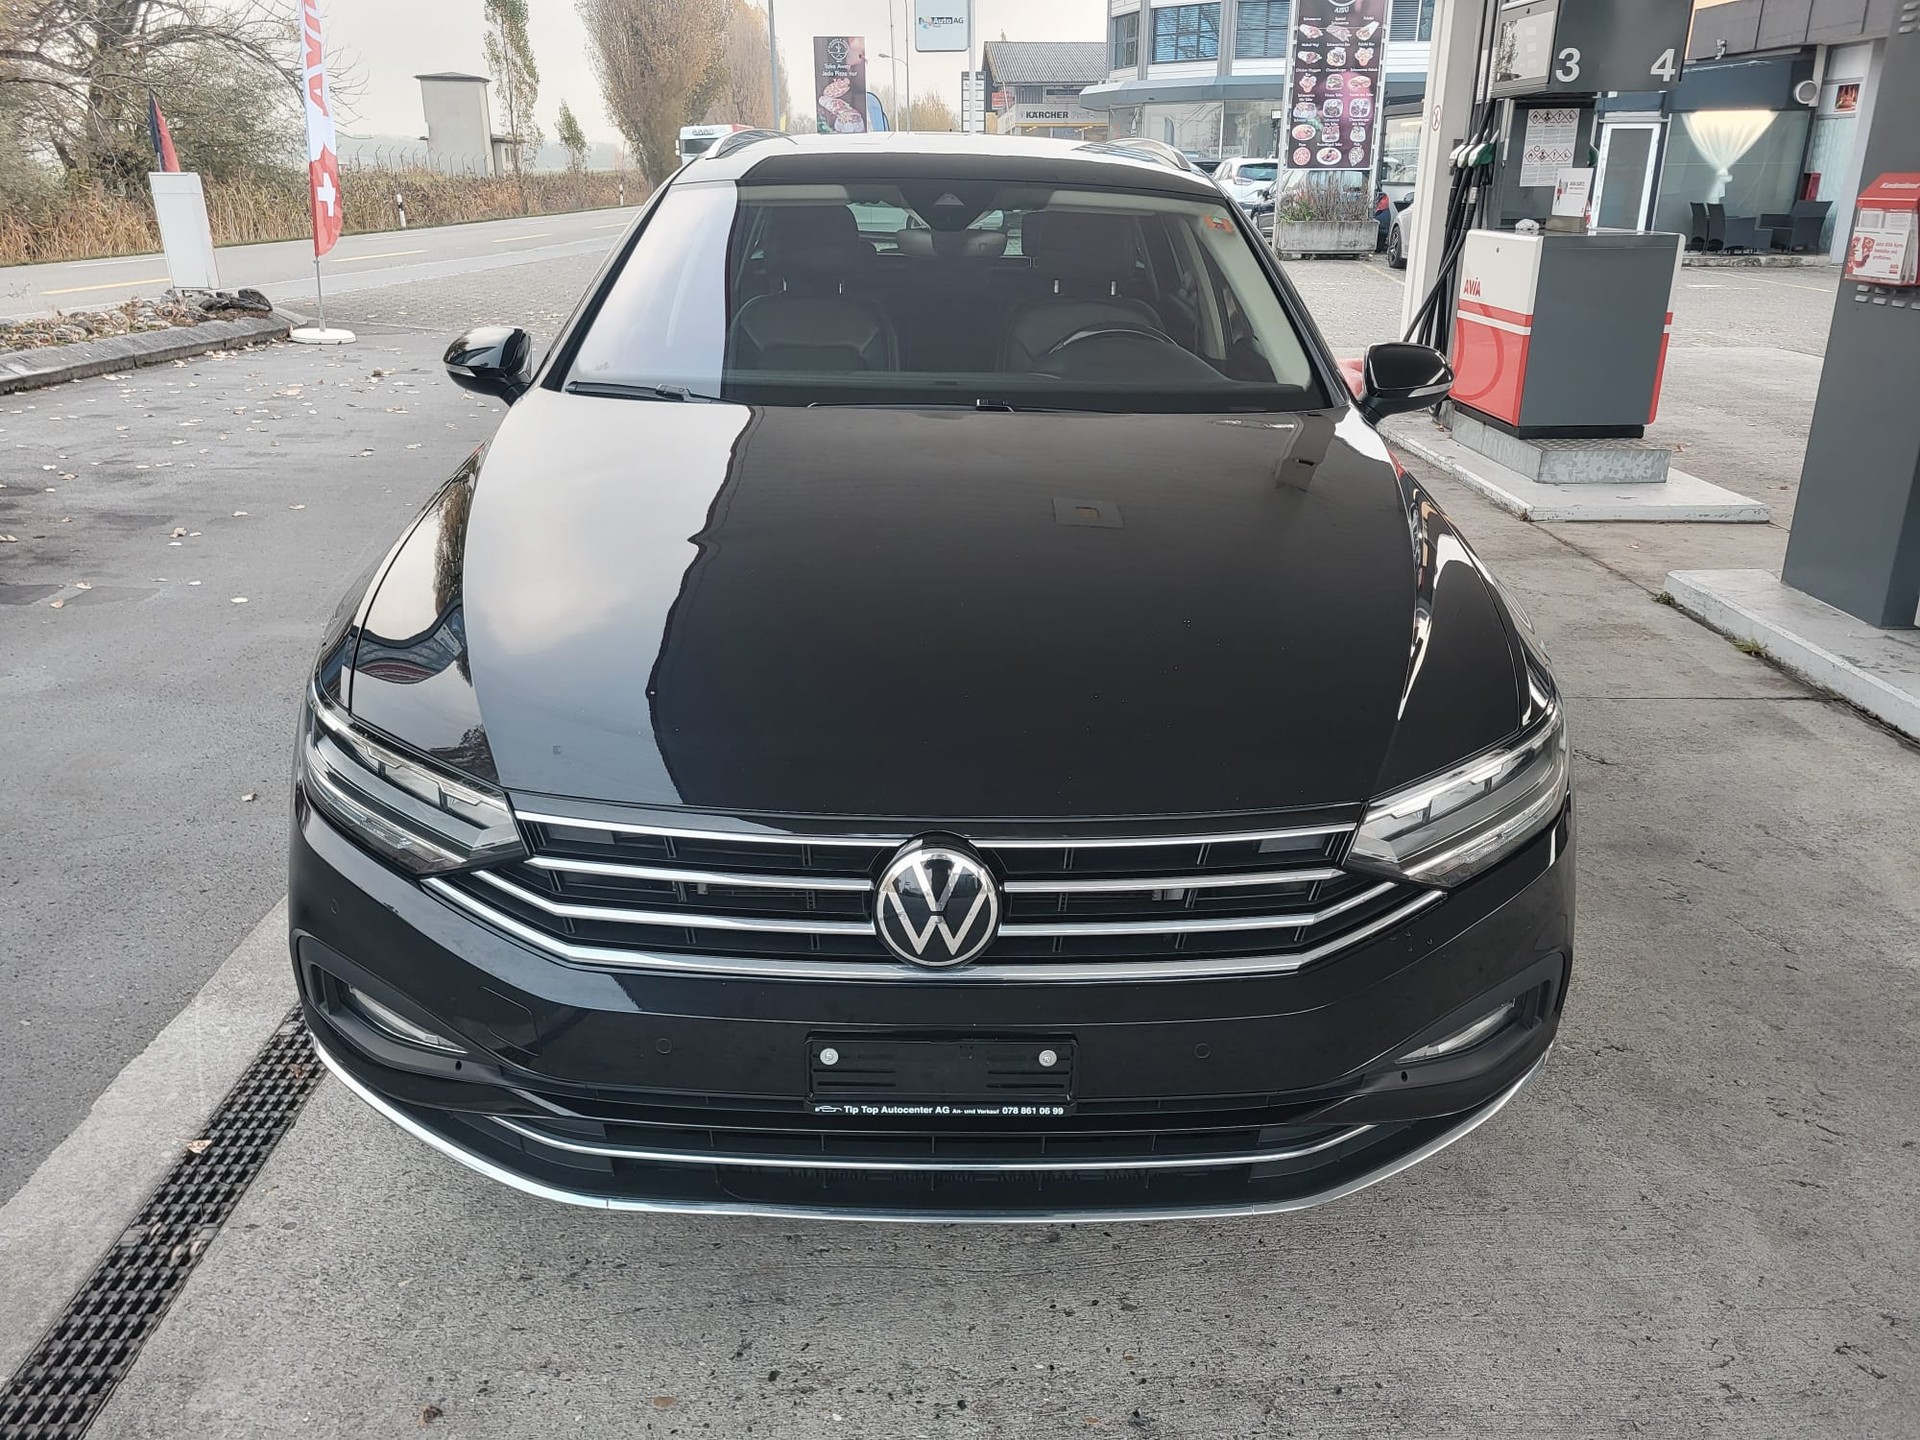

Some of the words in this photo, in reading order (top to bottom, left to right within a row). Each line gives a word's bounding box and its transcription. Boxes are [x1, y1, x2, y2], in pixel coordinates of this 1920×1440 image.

[305, 0, 329, 117] AVI
[1555, 47, 1581, 83] 3
[1649, 48, 1676, 82] 4
[1025, 111, 1069, 119] KÄRCHER
[1463, 277, 1481, 297] AVIA
[882, 850, 992, 957] VW
[844, 1106, 858, 1116] Tip
[861, 1106, 879, 1116] Top
[881, 1106, 933, 1115] Autocenter
[935, 1106, 950, 1115] AG
[1002, 1107, 1019, 1115] 078
[1020, 1107, 1037, 1115] 861
[1039, 1107, 1051, 1115] 06
[1052, 1107, 1064, 1115] 99
